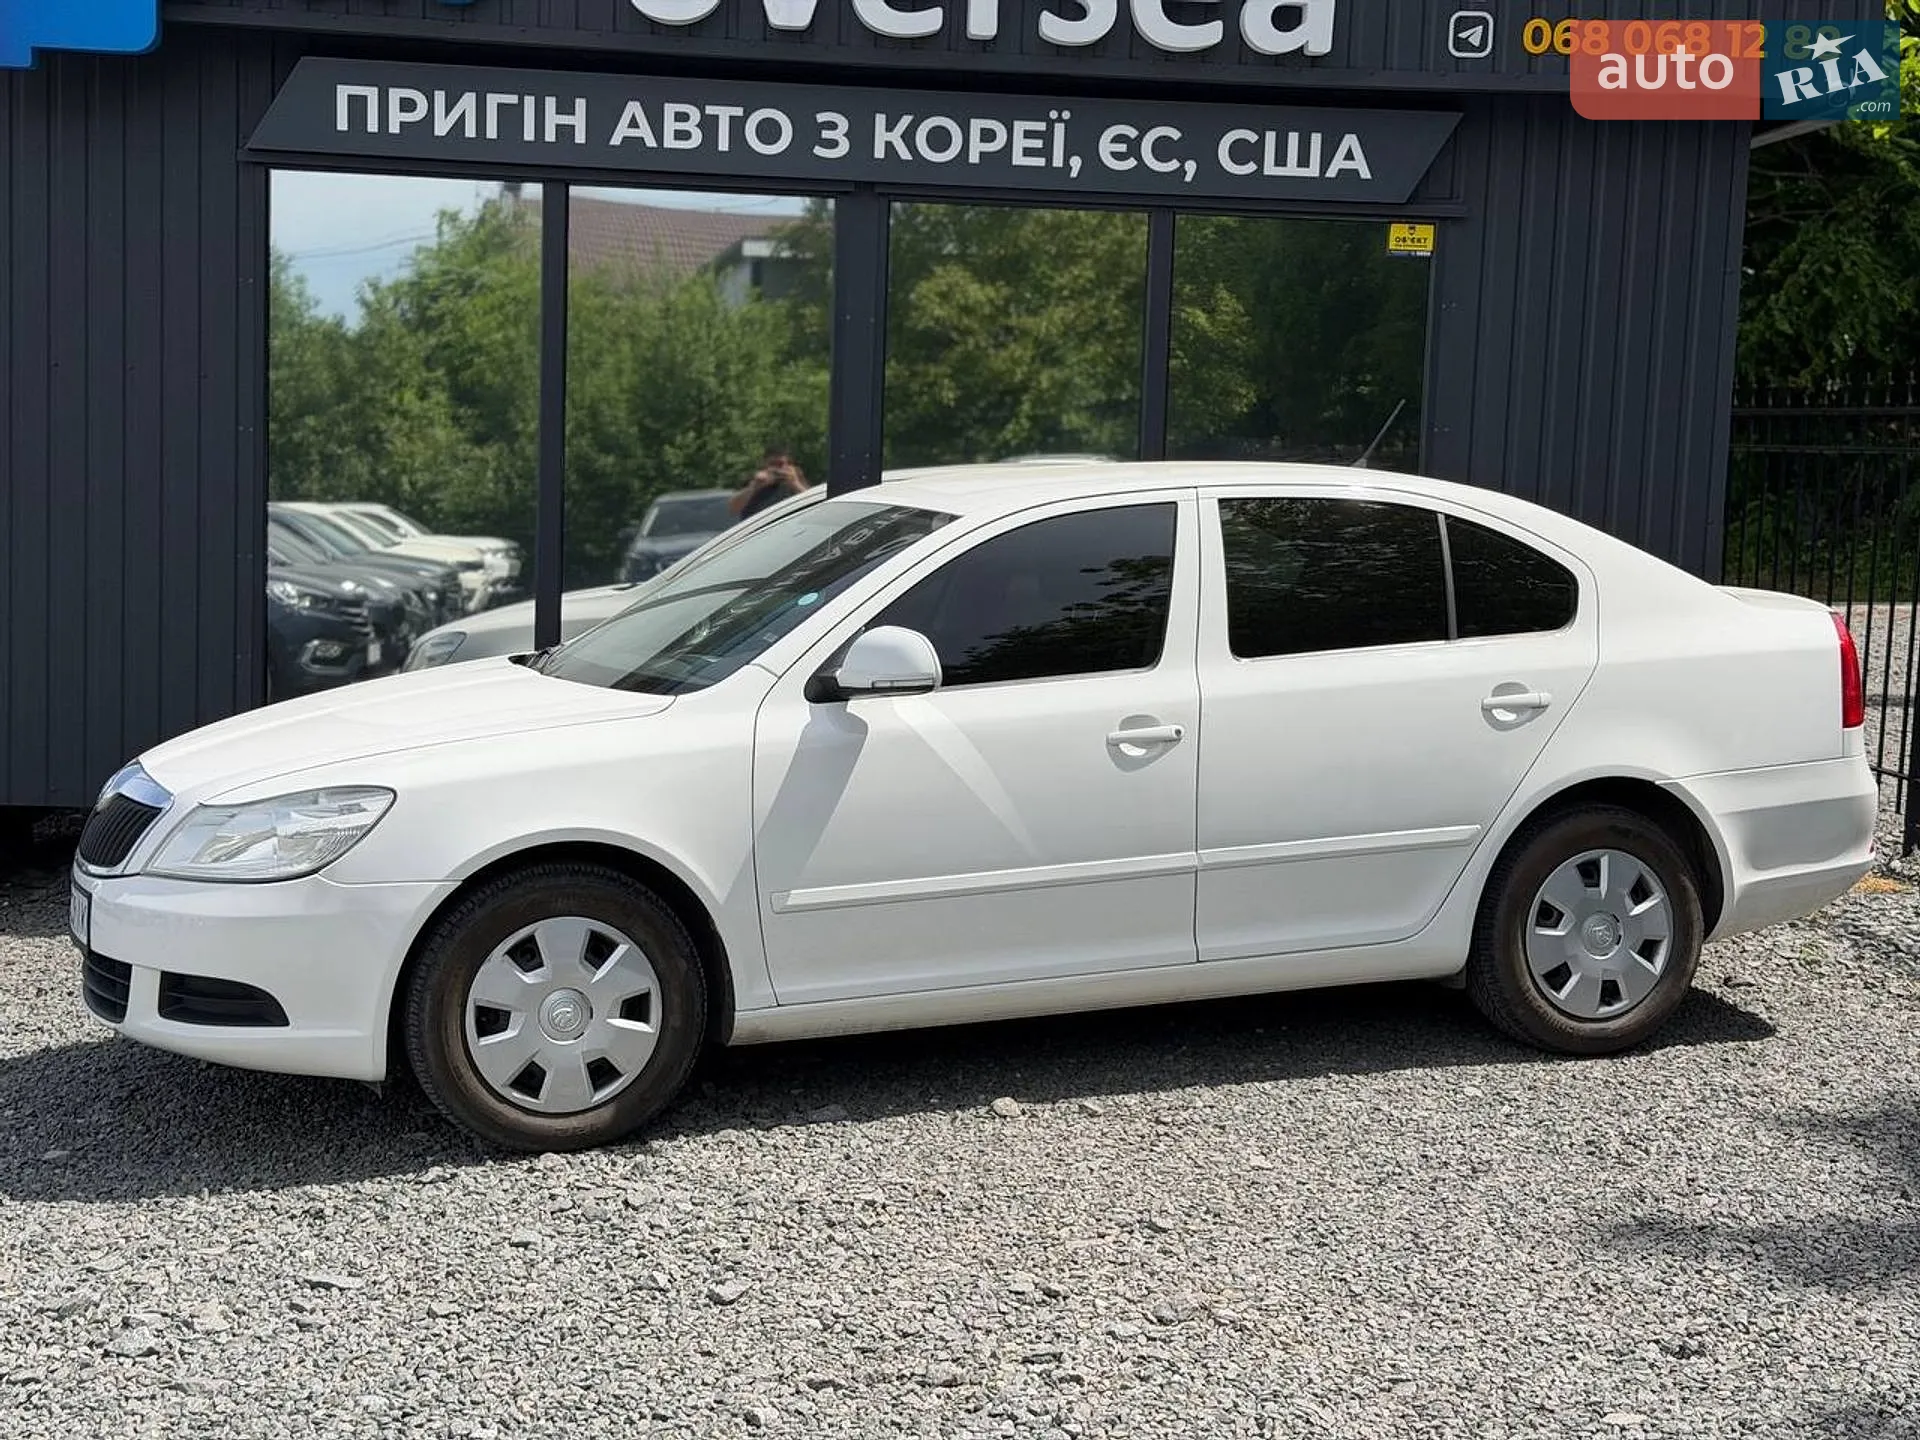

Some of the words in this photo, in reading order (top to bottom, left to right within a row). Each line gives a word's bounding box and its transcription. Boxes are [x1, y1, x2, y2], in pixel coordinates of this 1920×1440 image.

[1522, 18, 1610, 56] 068
[1623, 20, 1711, 58] 068
[1725, 23, 1769, 59] 12
[336, 84, 587, 144] ПРИГІН
[608, 100, 793, 156] АВТО
[812, 111, 850, 159] З
[873, 110, 1083, 178] КОРЕЇ,
[1098, 124, 1197, 183] ЄС,
[1217, 128, 1372, 180] США
